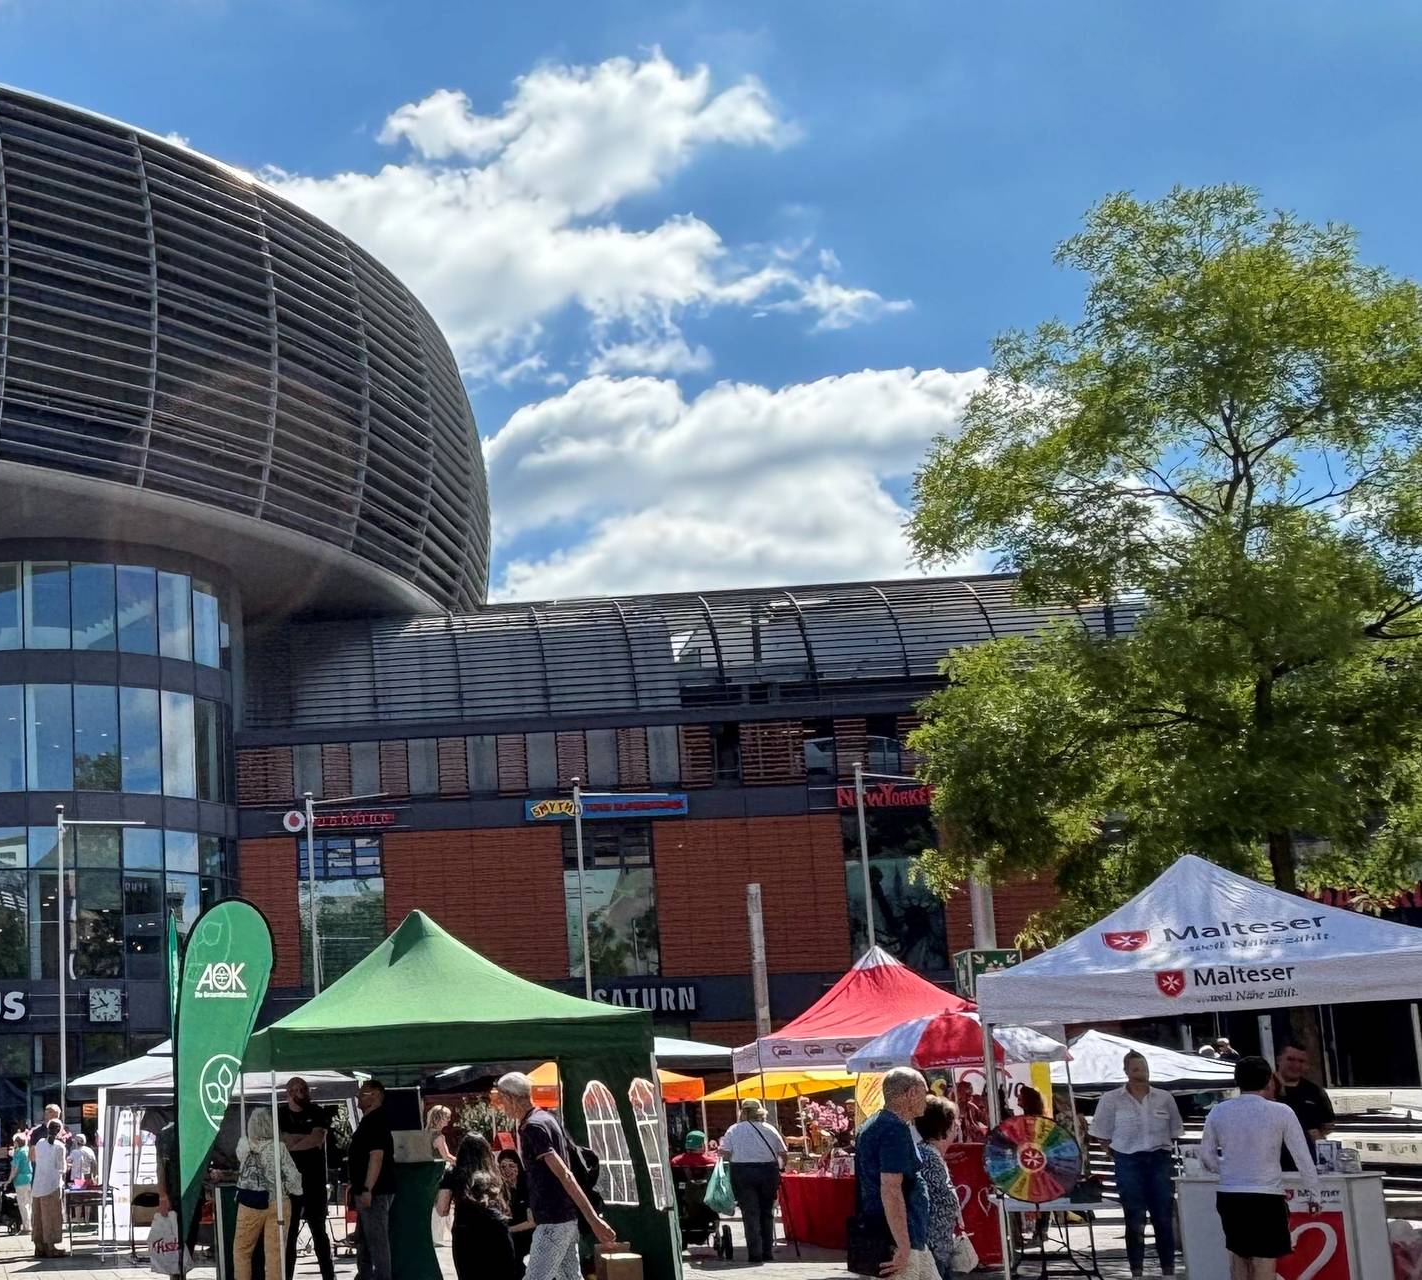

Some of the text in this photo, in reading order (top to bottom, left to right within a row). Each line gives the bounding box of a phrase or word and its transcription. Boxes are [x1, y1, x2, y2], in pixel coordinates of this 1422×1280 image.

[1164, 915, 1327, 942] Malteser
[195, 962, 247, 991] AOK
[1193, 965, 1295, 987] Malteser
[593, 986, 696, 1011] SATURN
